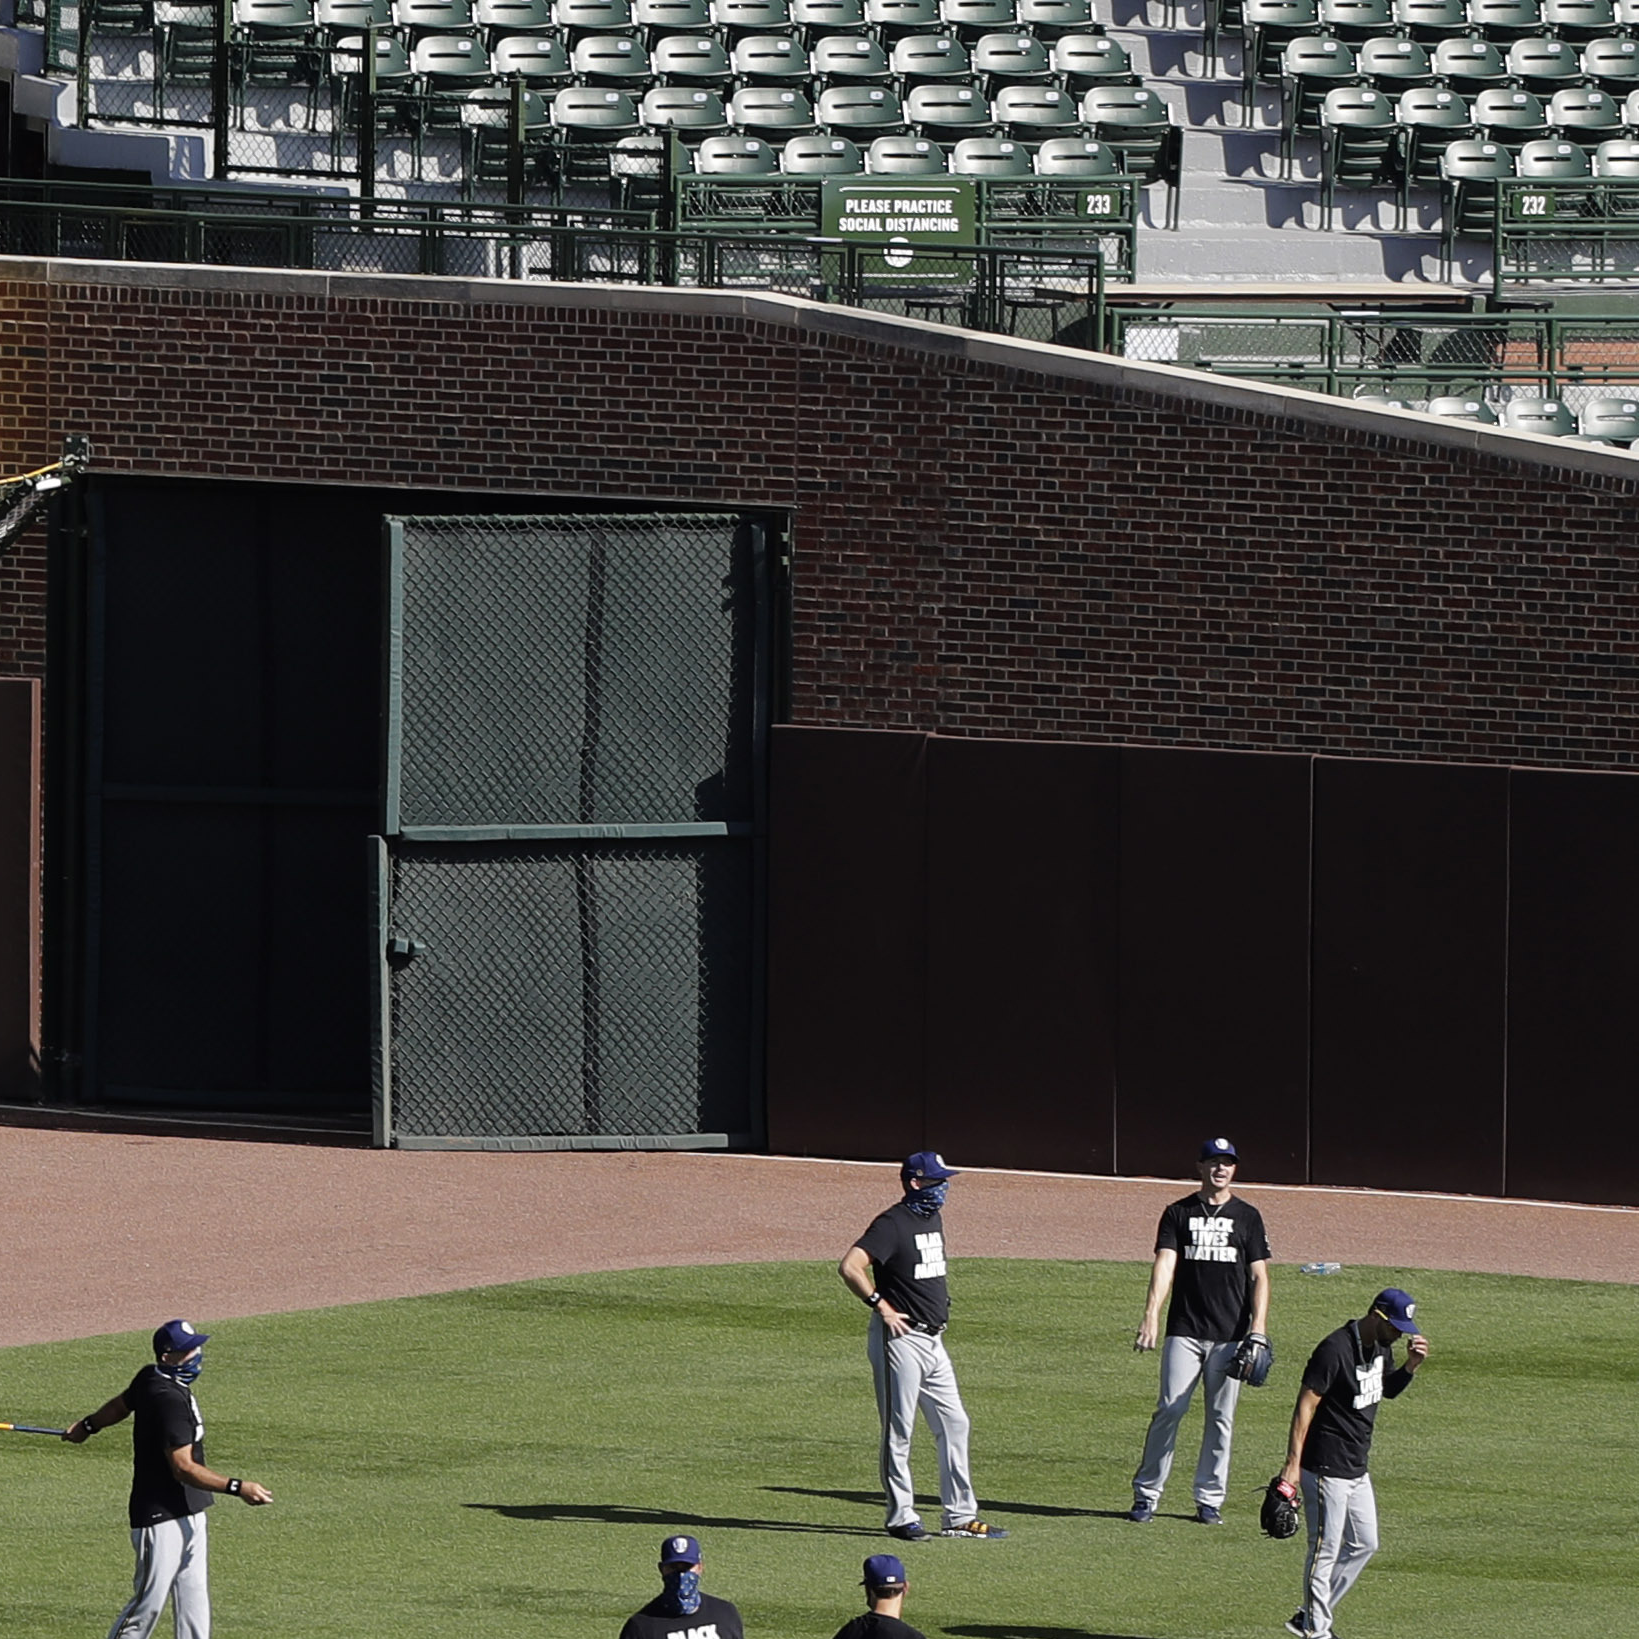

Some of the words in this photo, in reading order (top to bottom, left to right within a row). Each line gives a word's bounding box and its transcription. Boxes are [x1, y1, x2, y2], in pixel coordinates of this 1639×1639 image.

[845, 199, 891, 214] PLEASE
[894, 199, 953, 214] PRACTICE
[1086, 194, 1111, 214] 233
[1522, 196, 1546, 215] 232
[839, 217, 883, 232] SOCIAL
[885, 217, 960, 232] DISTANCING
[1188, 1216, 1234, 1233] BLACK
[1192, 1230, 1229, 1247] LIVES
[1184, 1245, 1238, 1263] MATTER
